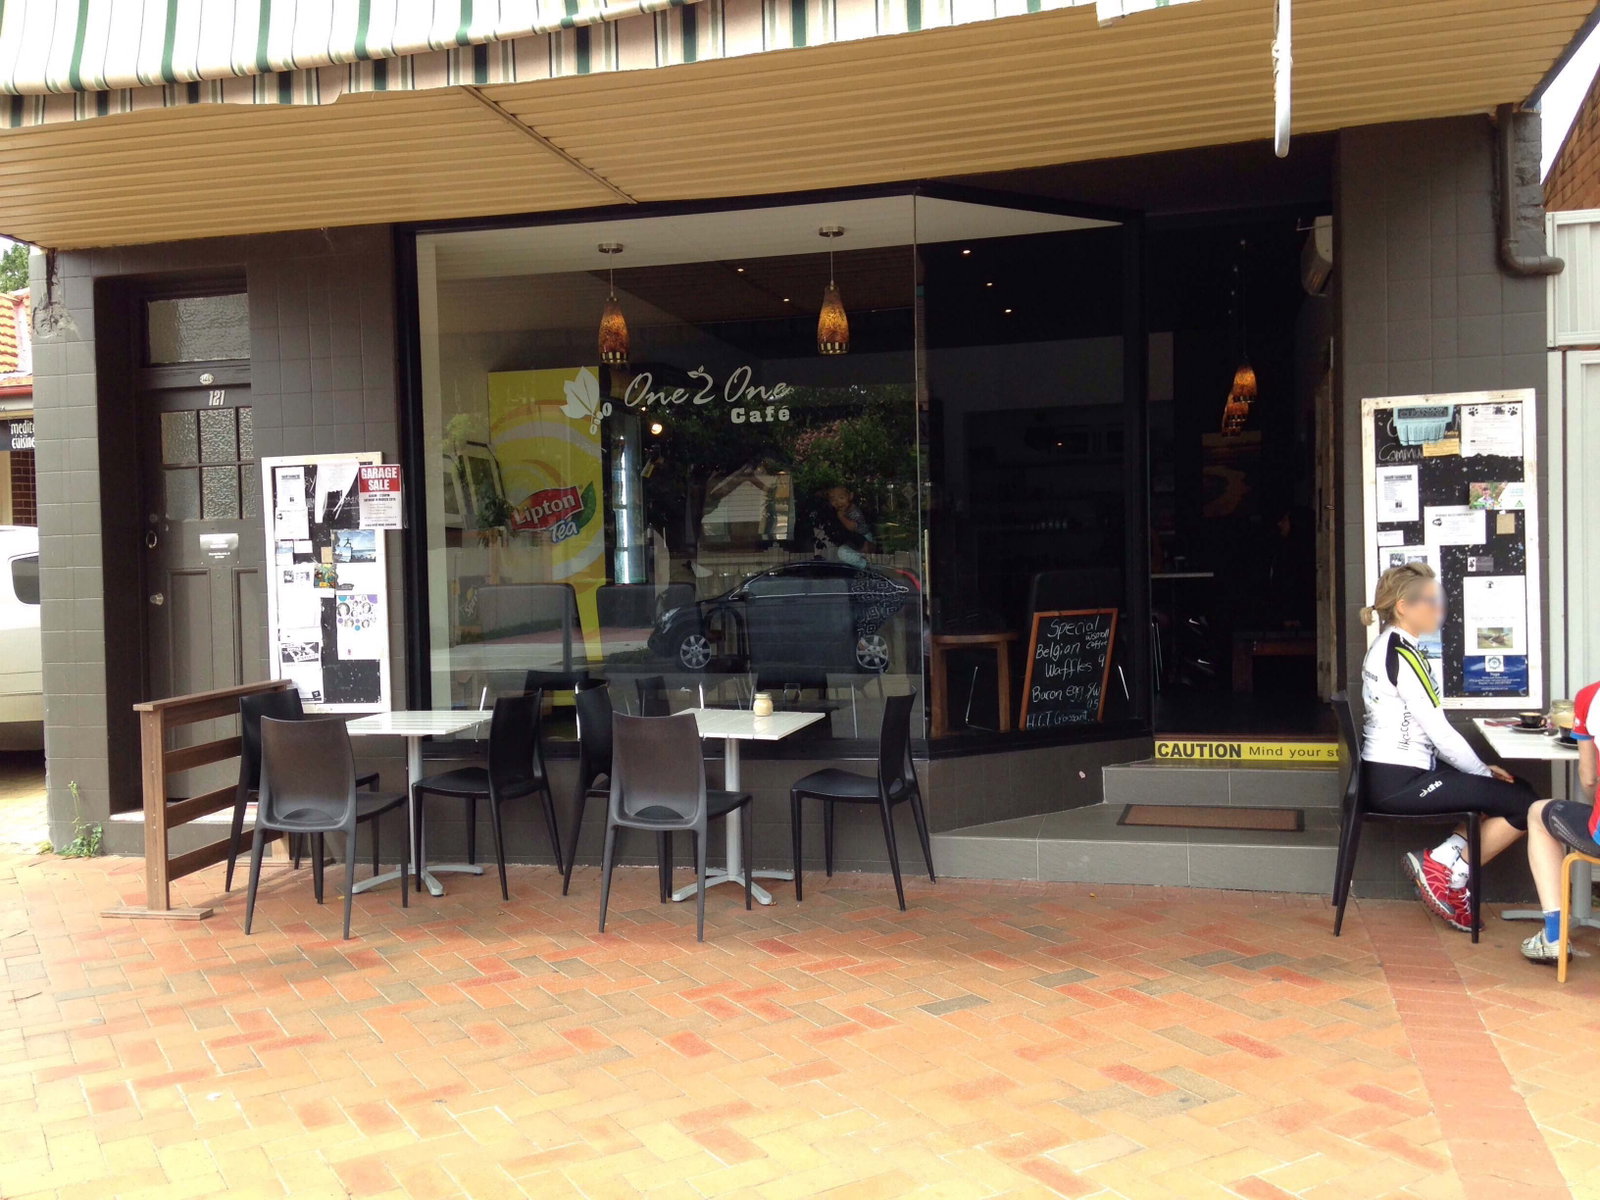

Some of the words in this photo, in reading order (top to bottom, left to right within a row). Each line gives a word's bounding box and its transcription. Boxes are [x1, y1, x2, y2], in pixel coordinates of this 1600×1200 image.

[624, 372, 689, 407] One
[690, 366, 716, 405] 2
[724, 365, 793, 403] One
[209, 389, 225, 406] 121
[731, 405, 790, 424] Café
[361, 466, 397, 479] GARAGE
[368, 479, 390, 491] SALE
[512, 494, 576, 525] Lipton
[549, 519, 578, 543] Tea
[1047, 615, 1100, 640] Special
[1045, 657, 1093, 681] Waffles
[1032, 685, 1063, 703] Bacon
[1157, 742, 1242, 758] CAUTION
[1249, 745, 1283, 757] Mind
[1289, 747, 1321, 758] your
